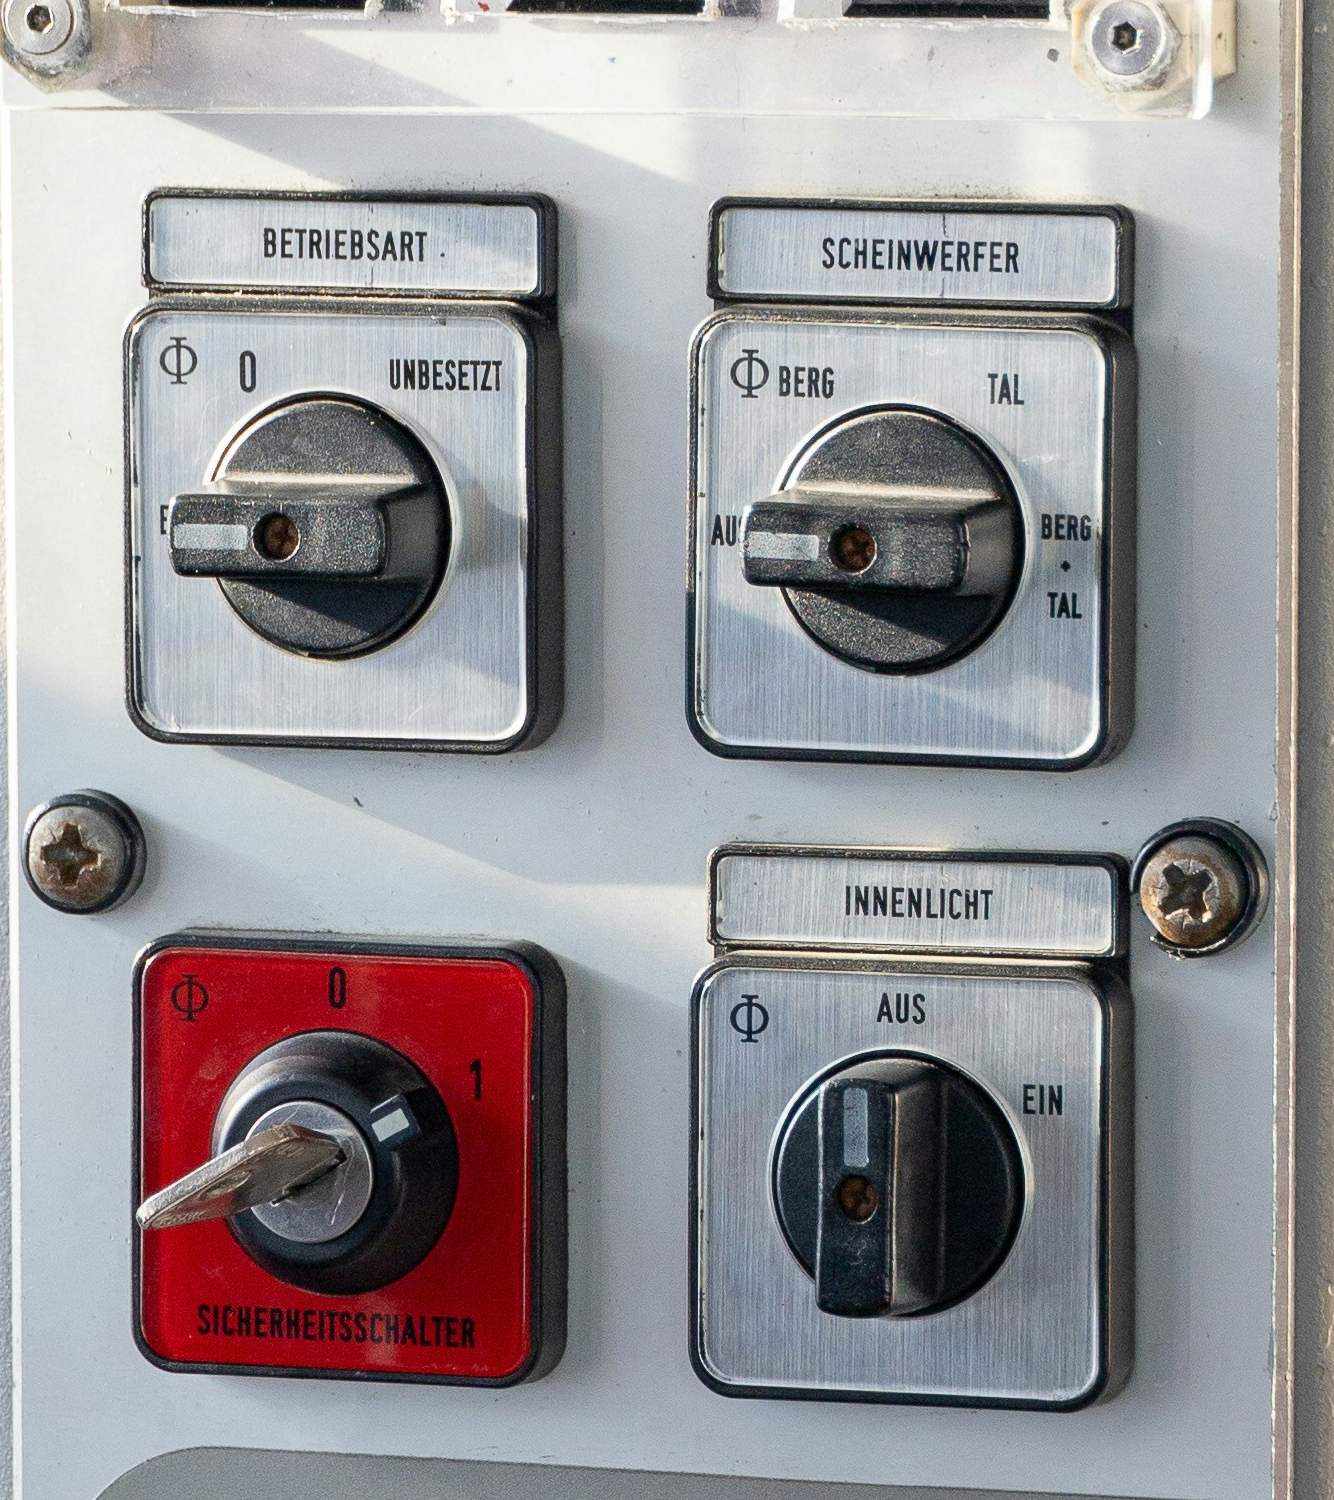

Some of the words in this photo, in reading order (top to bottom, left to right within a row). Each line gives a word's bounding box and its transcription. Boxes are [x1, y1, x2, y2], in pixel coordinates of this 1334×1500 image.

[262, 226, 429, 263] BETRIEBSART
[820, 236, 1020, 275] SCHEINWERFER
[238, 349, 258, 394] 0
[388, 357, 504, 393] UNBESETZT
[777, 364, 836, 400] BERG
[986, 372, 1026, 407] TAL
[1040, 512, 1093, 543] BERG
[1046, 590, 1084, 620] TAL
[844, 884, 995, 921] INNENLICHT
[327, 965, 348, 1011] 0
[875, 991, 927, 1026] AUS
[468, 1057, 483, 1102] 1
[1021, 1083, 1064, 1117] EIN
[197, 1303, 477, 1350] SICHERHEITSSCHALTER
